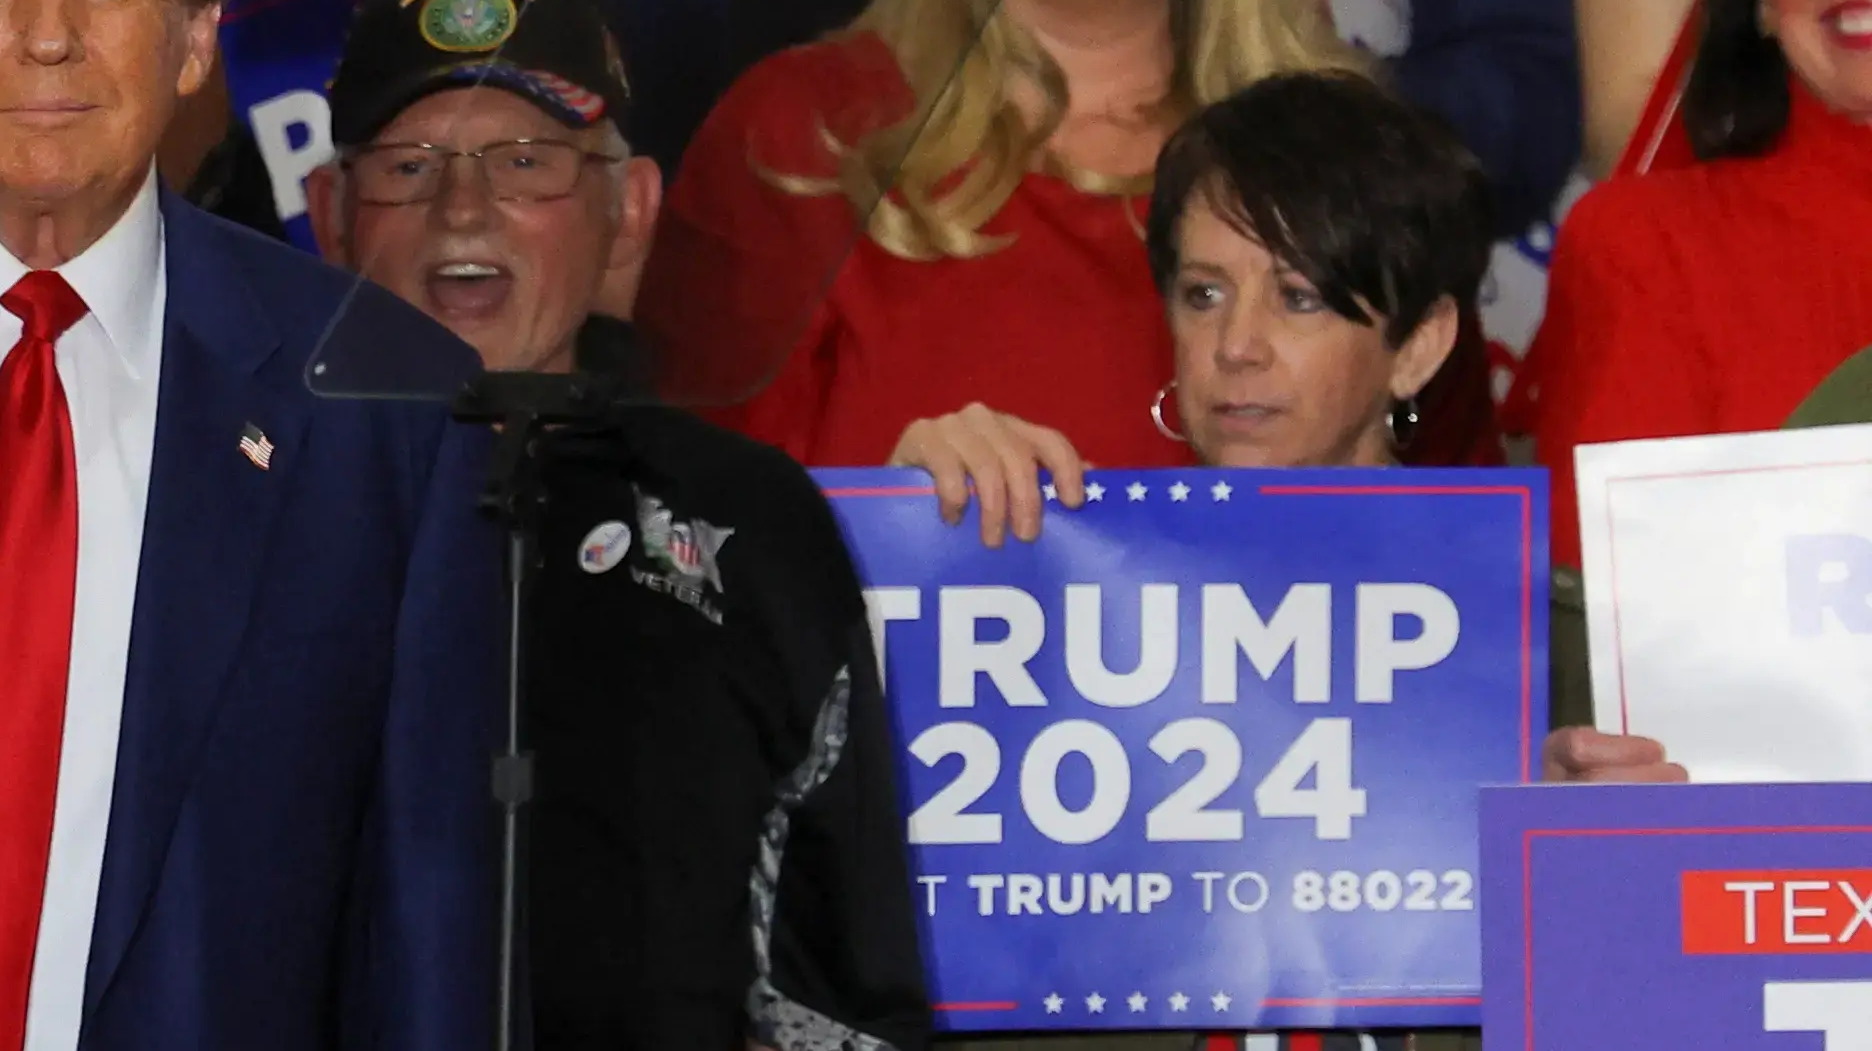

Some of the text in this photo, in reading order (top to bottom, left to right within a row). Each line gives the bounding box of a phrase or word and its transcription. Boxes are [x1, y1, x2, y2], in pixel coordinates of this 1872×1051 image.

[908, 717, 1367, 845] 2024
[969, 872, 1173, 916] TRUMP
[1193, 871, 1270, 913] TO
[1292, 869, 1474, 912] 88022
